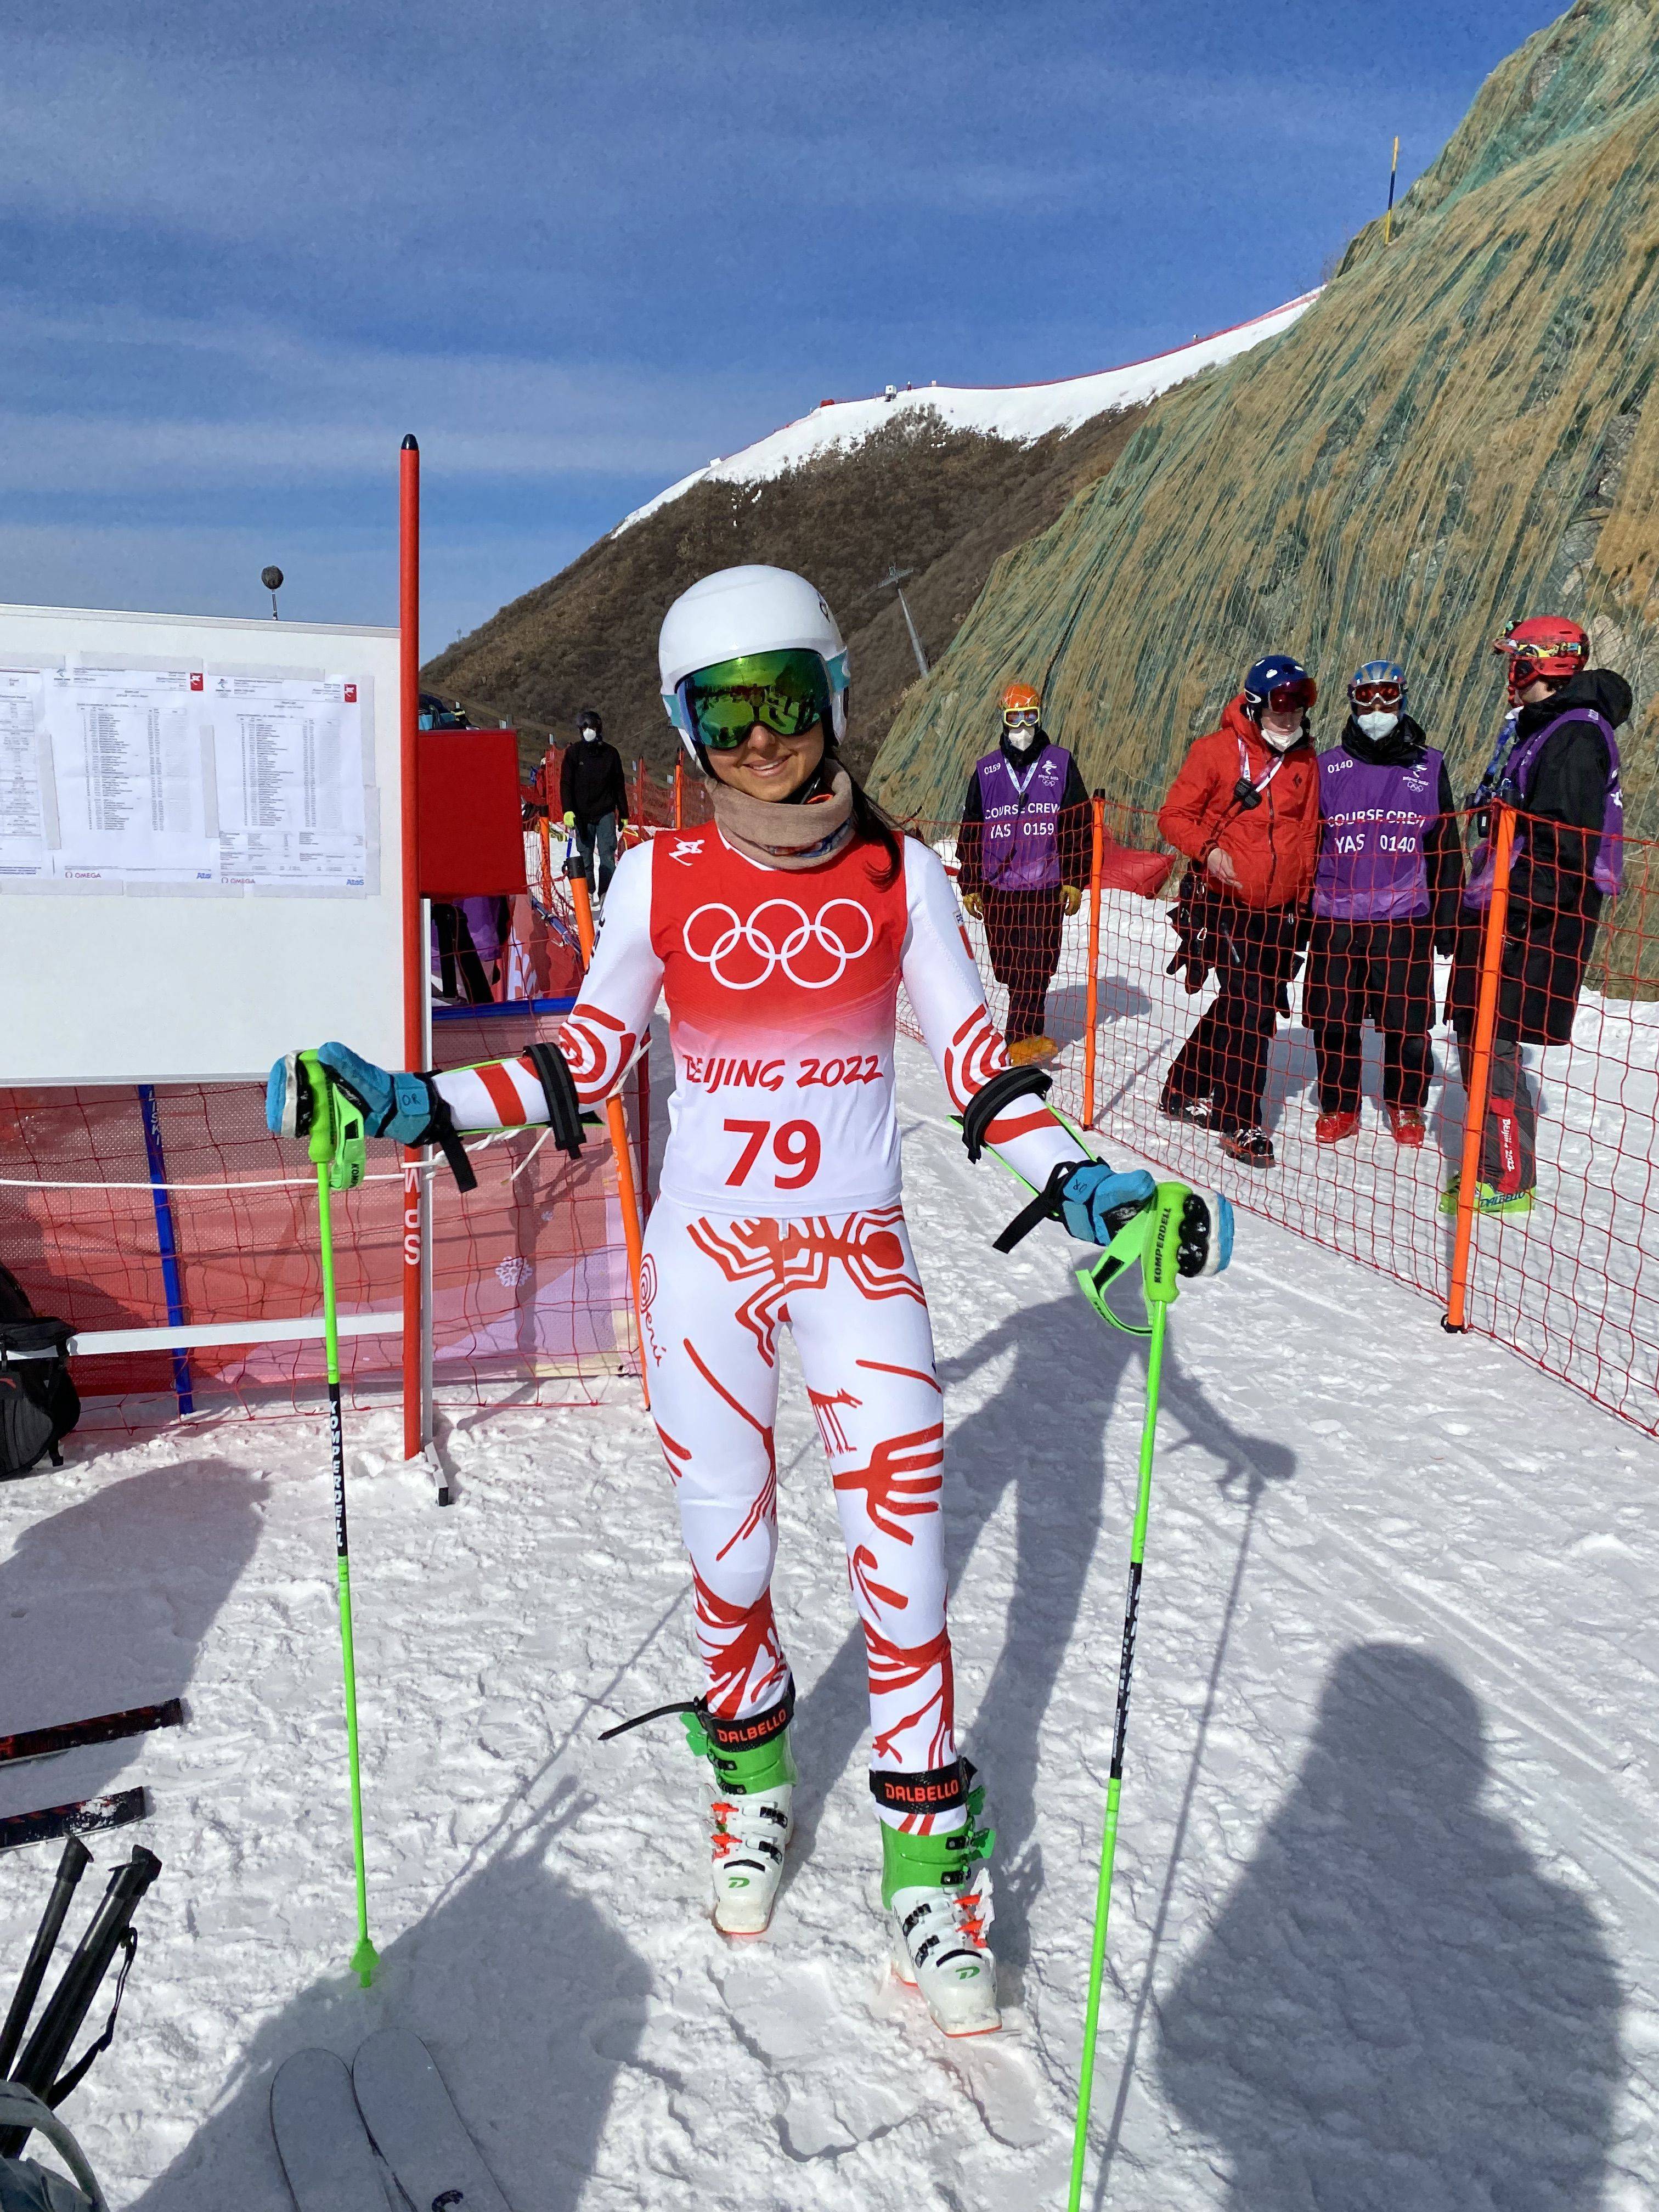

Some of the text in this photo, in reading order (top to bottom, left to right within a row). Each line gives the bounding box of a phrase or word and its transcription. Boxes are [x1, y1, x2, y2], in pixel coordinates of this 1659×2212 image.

[984, 763, 1001, 775] 0159
[1327, 760, 1353, 773] 0140
[1028, 803, 1060, 814] CREW
[1023, 822, 1054, 836] 0159
[1334, 833, 1415, 854] YAS 0140
[796, 1055, 884, 1088] 2022
[148, 1090, 161, 1146] LISKI
[724, 1119, 821, 1189] 79
[1505, 1149, 1515, 1172] 2022
[1154, 1208, 1171, 1283] KOMPERDELL
[329, 1401, 343, 1548] KOMPERDELL
[716, 1708, 786, 1743] DALBELLO
[884, 1779, 958, 1802] DALBELLO
